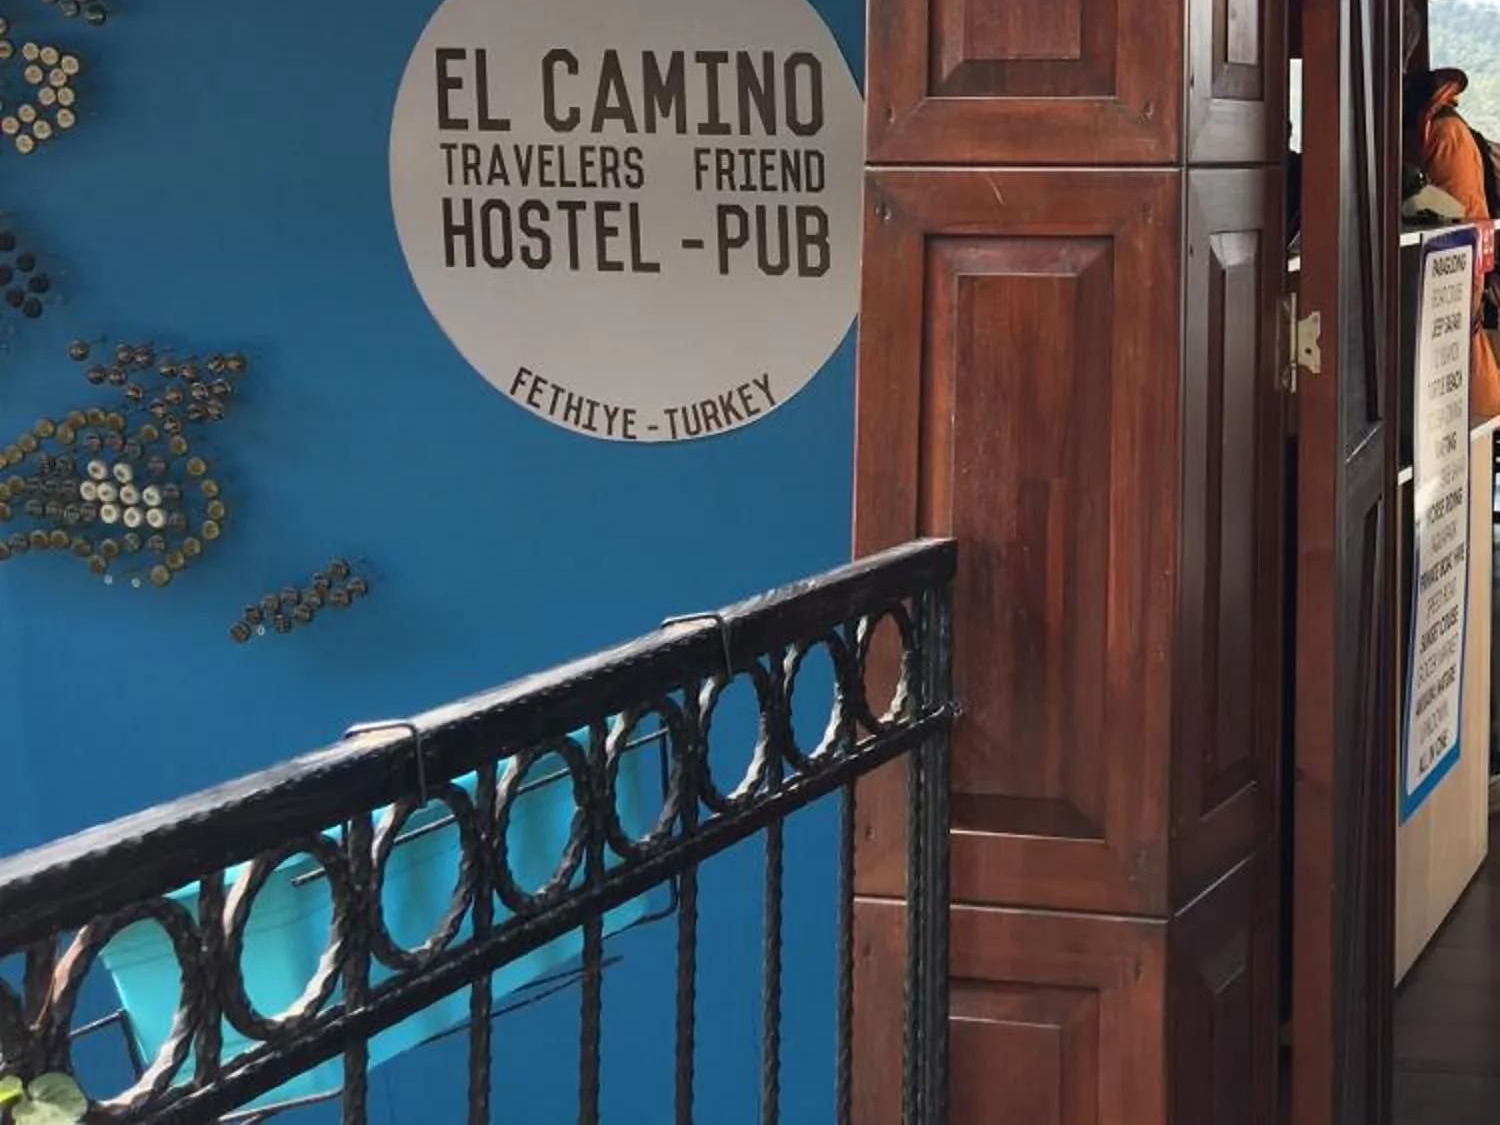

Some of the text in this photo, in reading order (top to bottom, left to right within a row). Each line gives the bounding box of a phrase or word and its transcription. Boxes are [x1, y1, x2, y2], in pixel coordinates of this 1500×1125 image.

[434, 47, 824, 137] EL CAMINO
[439, 142, 826, 194] TRAVELERS FRIEND
[441, 196, 661, 274] HOSTEL
